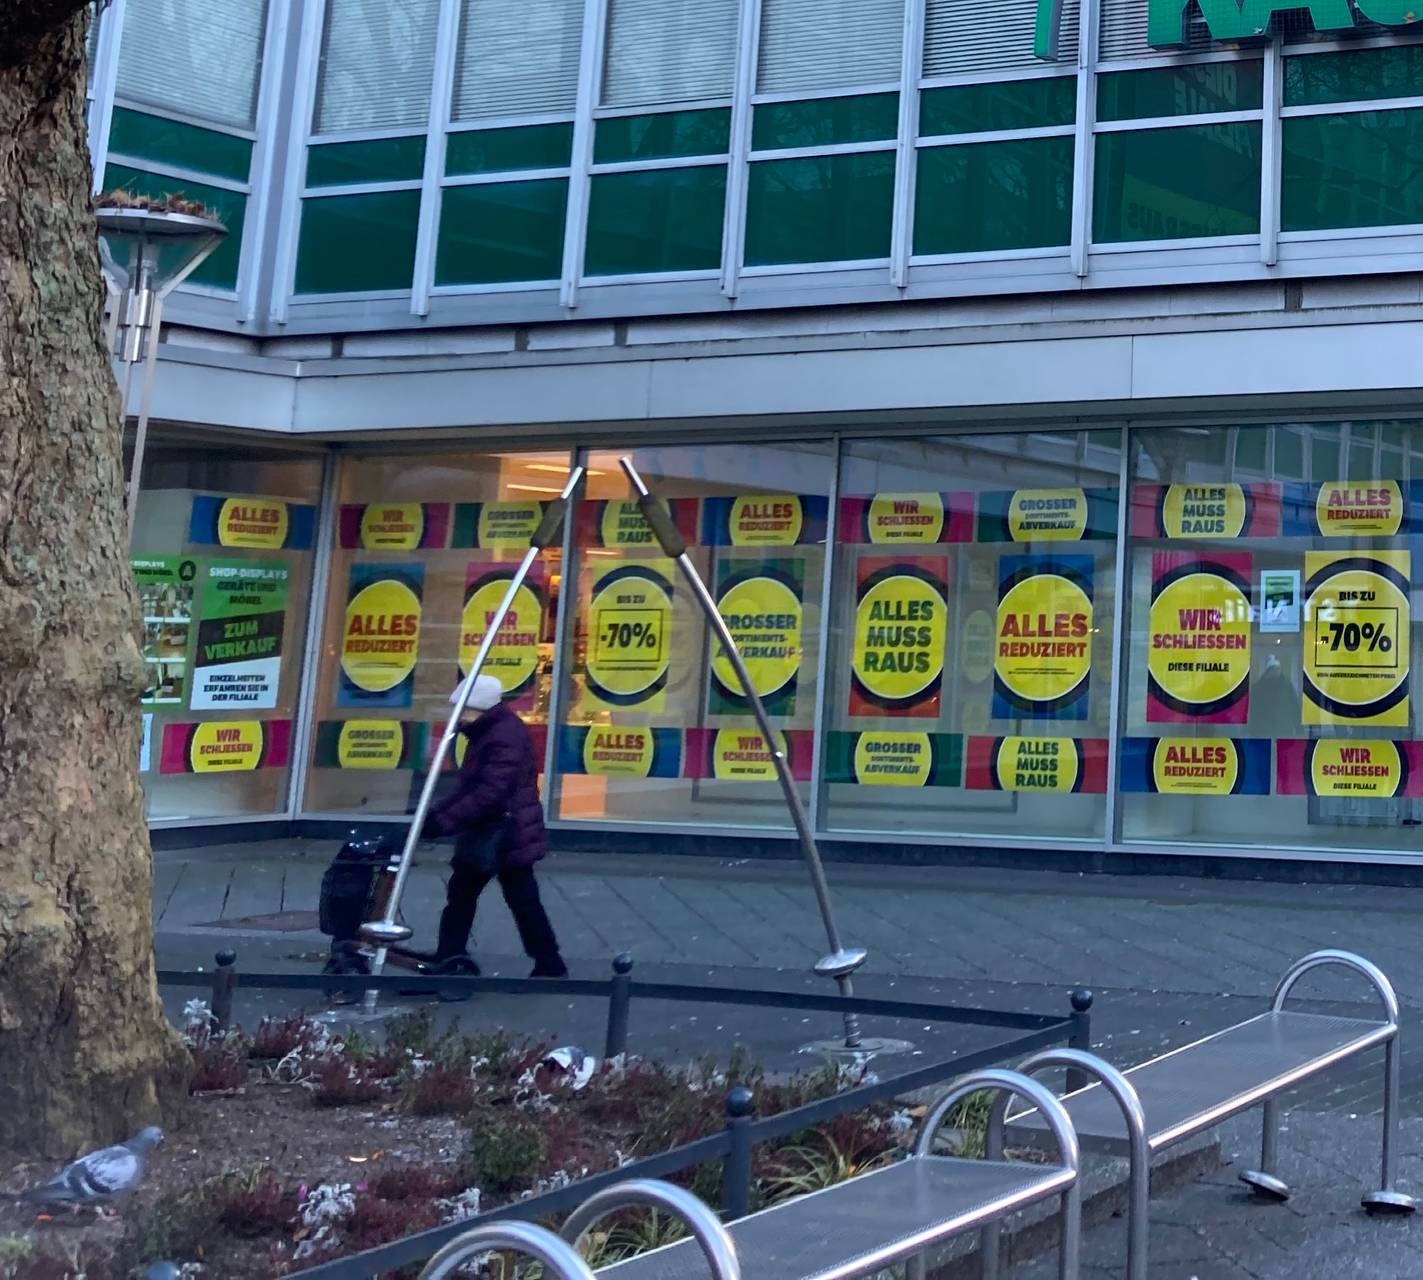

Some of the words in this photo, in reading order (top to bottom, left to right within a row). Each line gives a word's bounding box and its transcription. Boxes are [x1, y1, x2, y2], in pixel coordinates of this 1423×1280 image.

[1183, 488, 1226, 501] ALLES
[1328, 489, 1392, 506] ALLES
[740, 503, 794, 519] ALLES
[893, 500, 919, 515] WIR
[1018, 497, 1077, 511] GROSSER
[1182, 504, 1226, 518] MUSS
[229, 506, 281, 523] ALLES
[1327, 509, 1392, 521] REDUZIERT
[1018, 519, 1077, 531] ABVERKAUF
[1181, 519, 1225, 534] RAUS
[209, 567, 288, 580] SHOP-DISPLAYS
[1338, 591, 1358, 602] BIS
[1359, 591, 1376, 602] ZU
[869, 600, 934, 621] ALLES
[347, 614, 418, 636] ALLES
[1000, 613, 1088, 638] ALLES
[1178, 608, 1222, 631] WIR
[224, 620, 259, 638] ZUM
[600, 622, 657, 649] -70%
[866, 626, 932, 648] MUSS
[1152, 633, 1247, 650] SCHLIESSEN
[1320, 622, 1393, 653] -70%
[205, 636, 277, 660] VERKAUF
[345, 639, 416, 654] REDUZIERT
[999, 641, 1087, 658] REDUZIERT
[863, 651, 931, 674] RAUS
[1168, 662, 1195, 672] DIESE
[1195, 662, 1230, 672] FILIALE
[215, 728, 242, 743] WIR
[593, 733, 645, 750] ALLES
[737, 736, 763, 750] WIR
[864, 742, 922, 755] GROSSER
[1017, 741, 1059, 755] ALLES
[1165, 746, 1227, 764] ALLES
[1339, 748, 1371, 764] WIR
[1016, 757, 1059, 771] MUSS
[1164, 765, 1227, 778] REDUZIERT
[1322, 765, 1389, 777] SCHLIESSEN
[1015, 773, 1059, 788] RAUS
